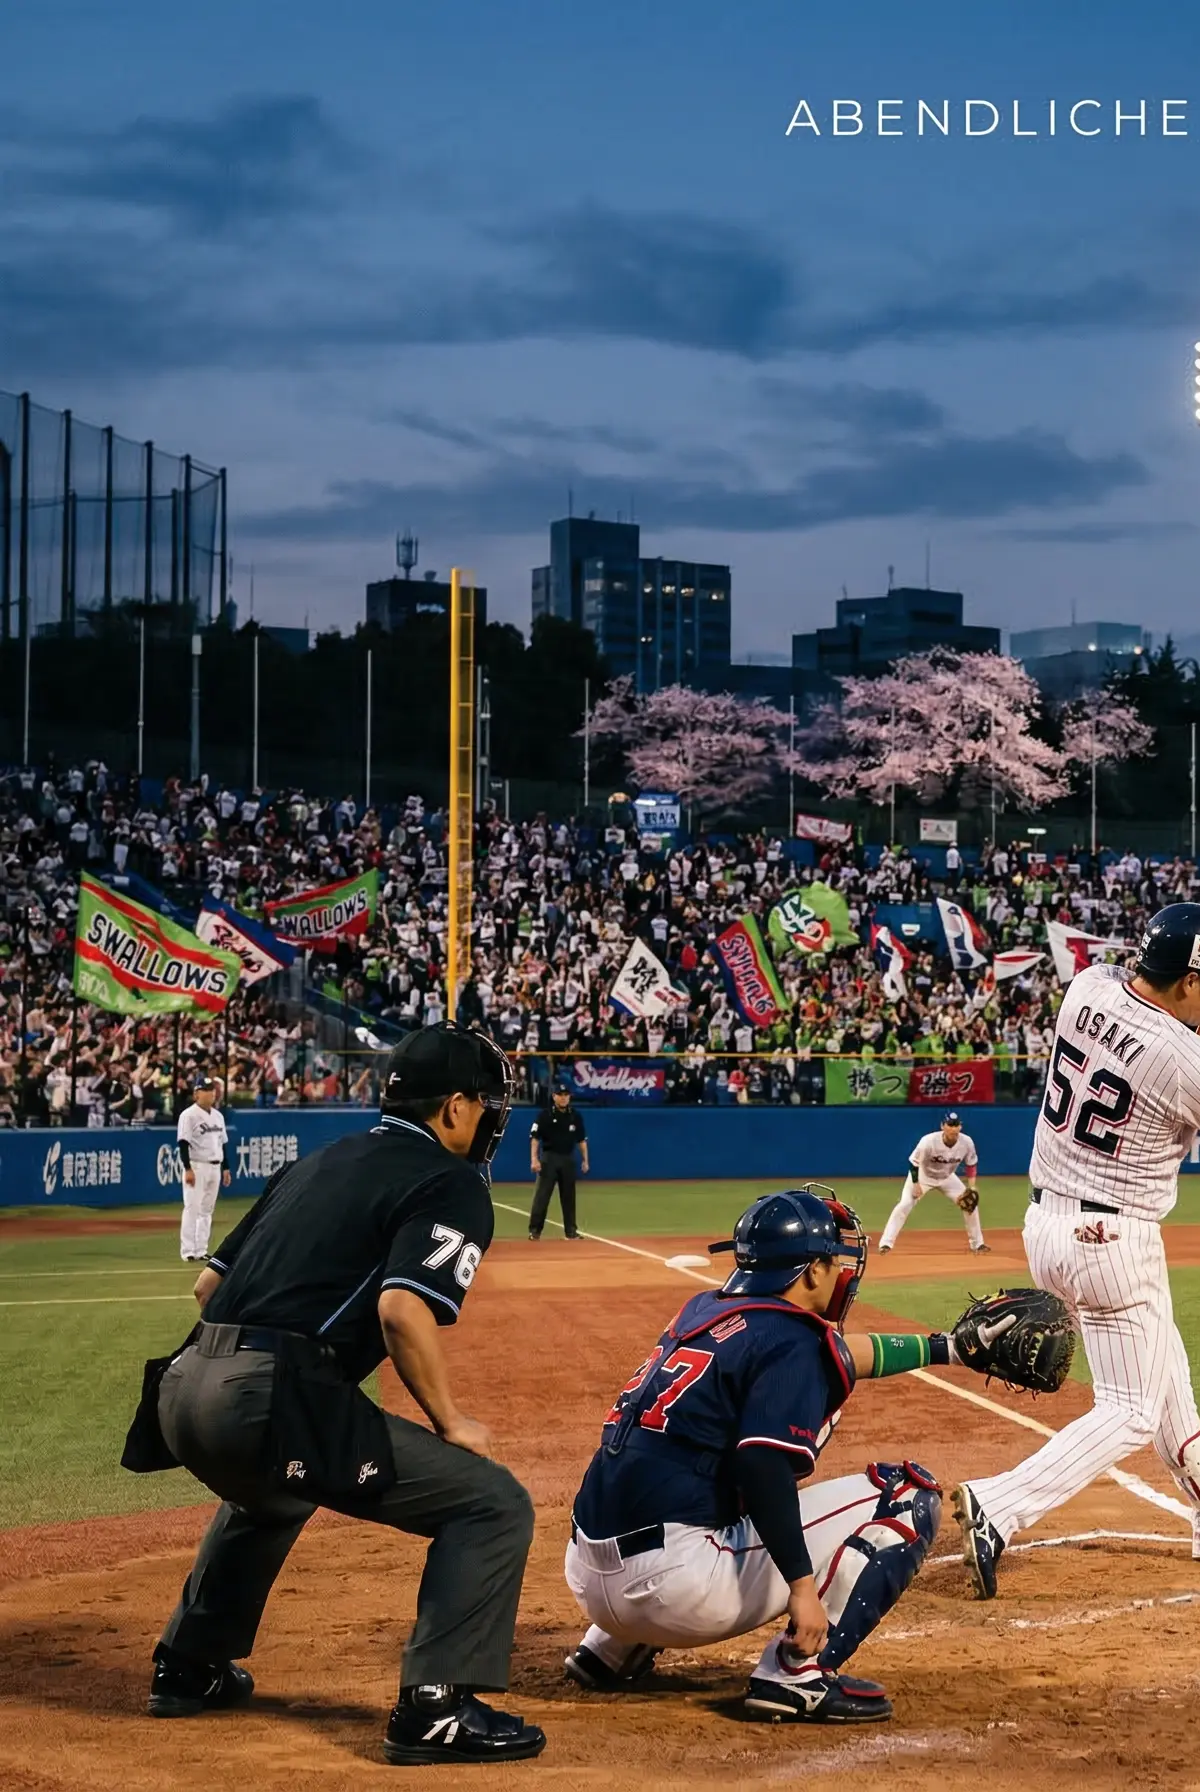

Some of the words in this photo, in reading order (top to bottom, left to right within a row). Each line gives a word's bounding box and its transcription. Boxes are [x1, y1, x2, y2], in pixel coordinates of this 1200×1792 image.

[87, 912, 229, 995] SWALLOWS
[1075, 1005, 1145, 1067] OSAKI
[1043, 1034, 1137, 1160] 52
